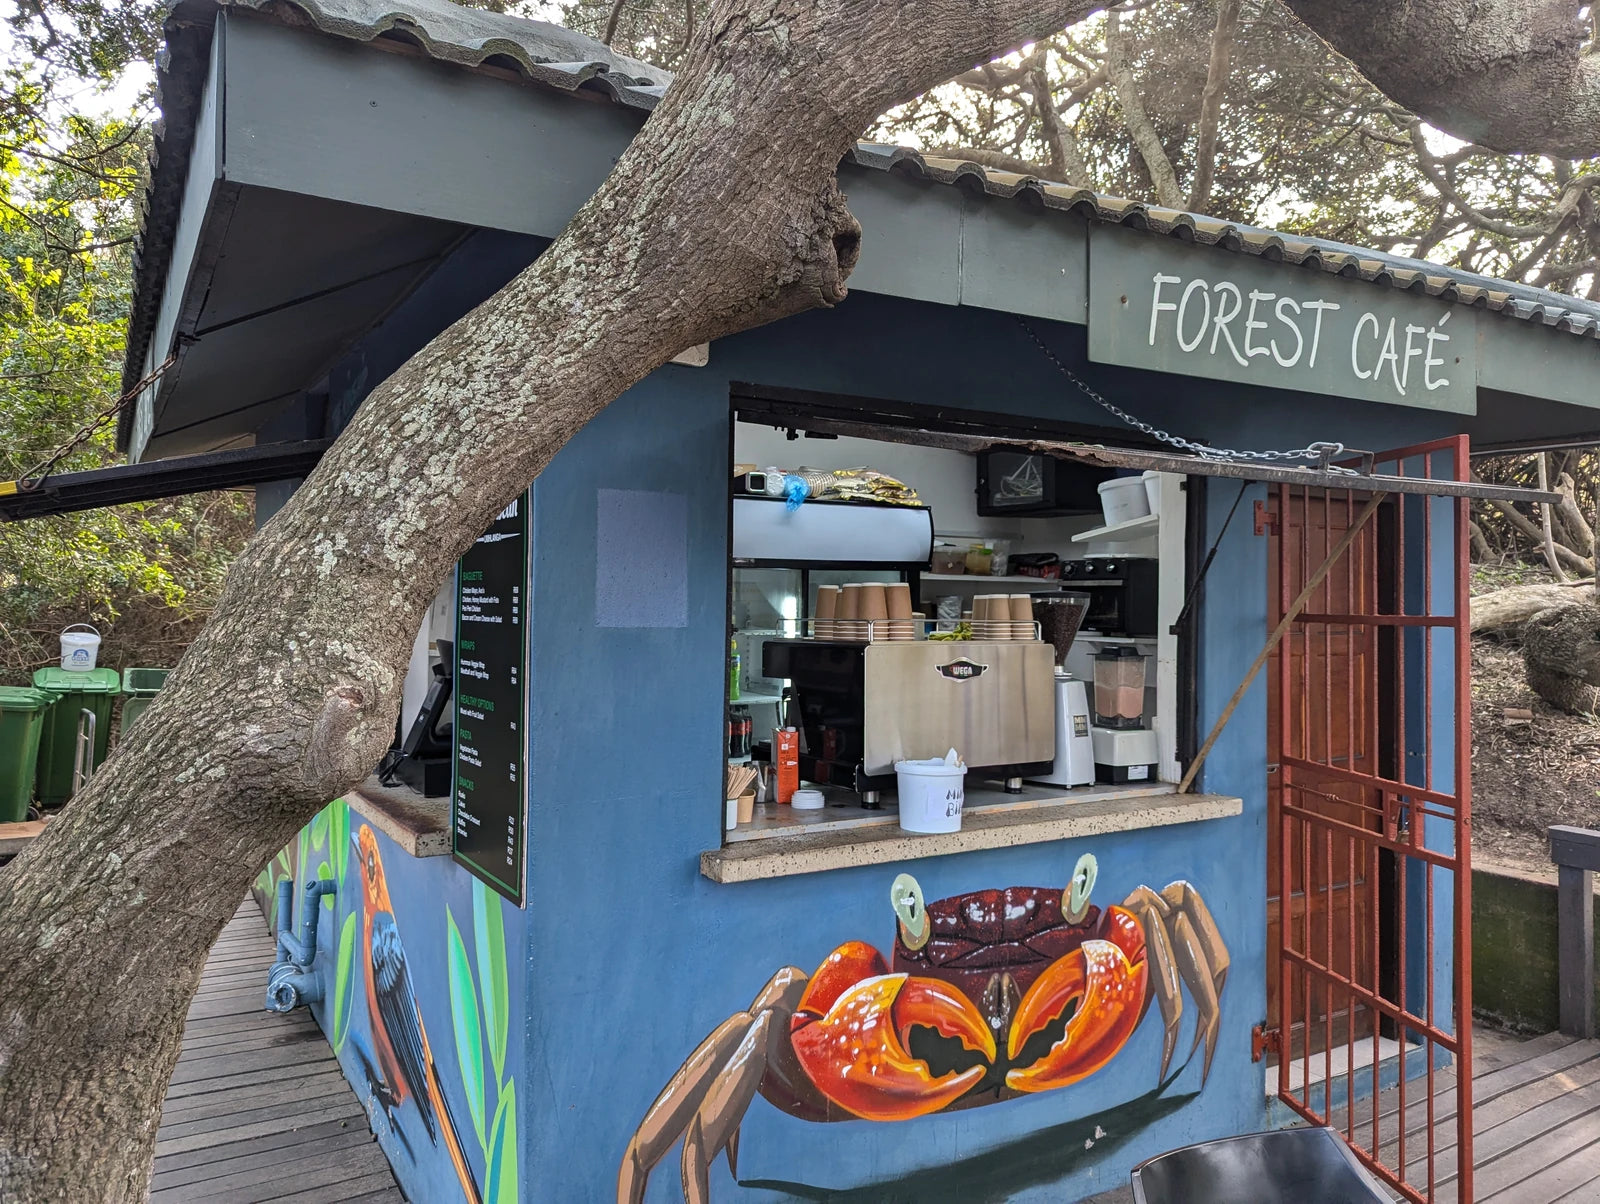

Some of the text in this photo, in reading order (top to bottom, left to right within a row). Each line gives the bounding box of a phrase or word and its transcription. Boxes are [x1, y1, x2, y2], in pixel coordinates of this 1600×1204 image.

[1148, 272, 1452, 395] FOREST CAFÉ
[952, 666, 973, 676] WEGA
[460, 694, 477, 705] HEALTHY
[477, 698, 494, 711] OPTIONS
[460, 728, 472, 741] PASTA
